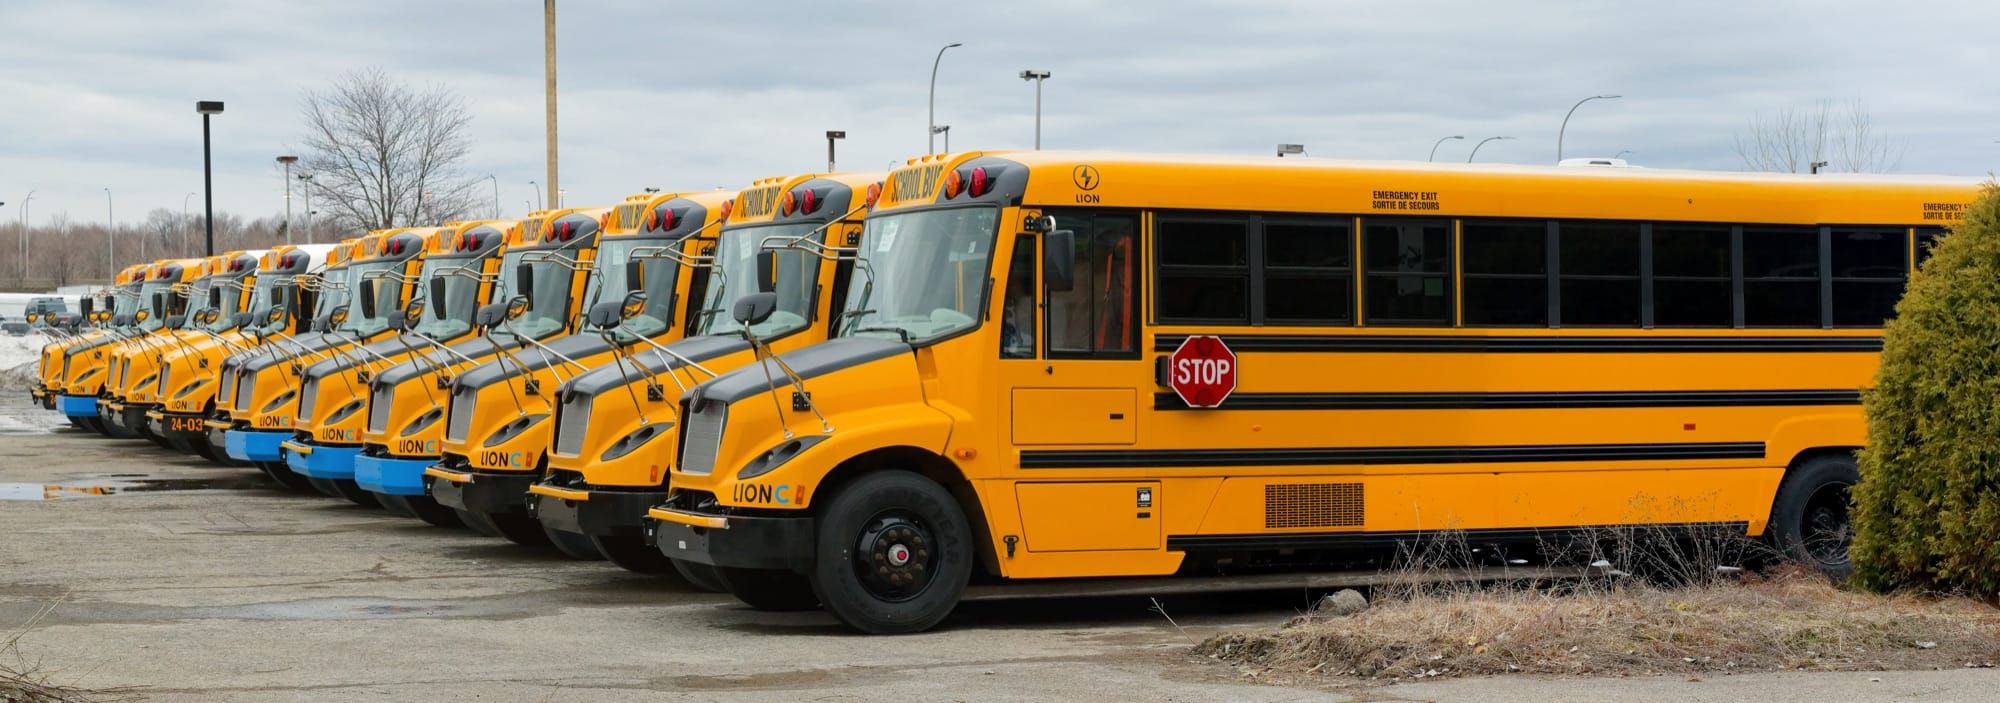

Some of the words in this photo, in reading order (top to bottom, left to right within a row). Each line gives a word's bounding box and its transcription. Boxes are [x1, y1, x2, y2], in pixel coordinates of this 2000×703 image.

[891, 167, 922, 202] SCHOOL
[1076, 194, 1099, 203] LION
[1373, 190, 1418, 200] EMERGENCY
[1421, 192, 1437, 200] EXIT
[1372, 201, 1397, 210] SORTIE
[1399, 202, 1407, 210] DE
[1409, 202, 1439, 210] SECOURS
[1923, 203, 1961, 211] EMERGENCY
[1923, 212, 1943, 220] SORTIE
[1178, 358, 1230, 385] STOP
[171, 417, 203, 432] 24-03
